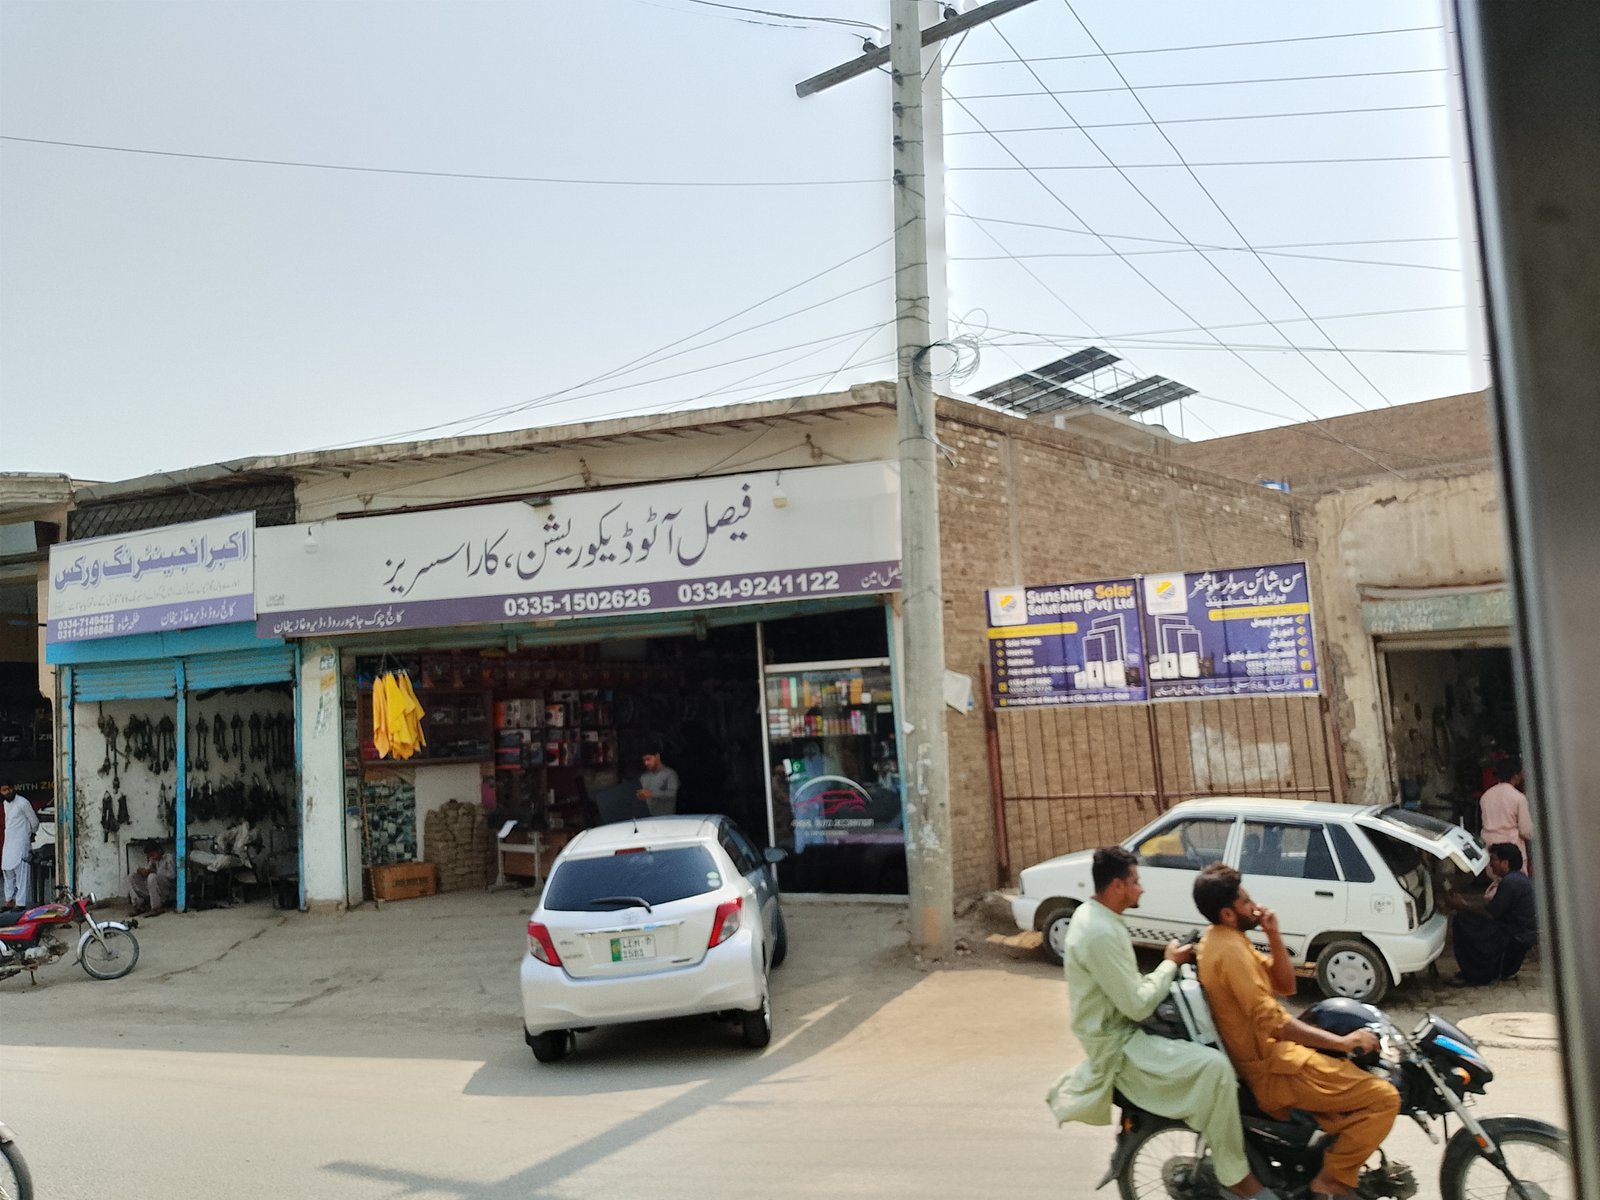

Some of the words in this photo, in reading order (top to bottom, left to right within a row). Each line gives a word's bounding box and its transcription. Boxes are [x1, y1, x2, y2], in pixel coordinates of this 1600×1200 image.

[635, 505, 682, 563] آٹو
[677, 483, 752, 566] فیصل
[205, 530, 249, 568] اکبر
[54, 555, 101, 590] ورکس
[677, 571, 840, 603] 0334-9241122
[1279, 572, 1302, 593] سن
[504, 587, 651, 616] 0335-1502626
[1026, 586, 1093, 604] Sunshine
[1095, 583, 1134, 600] Solar
[1026, 601, 1082, 616] Solutions
[1084, 598, 1113, 614] (Pvt)
[1114, 597, 1135, 610] Ltd
